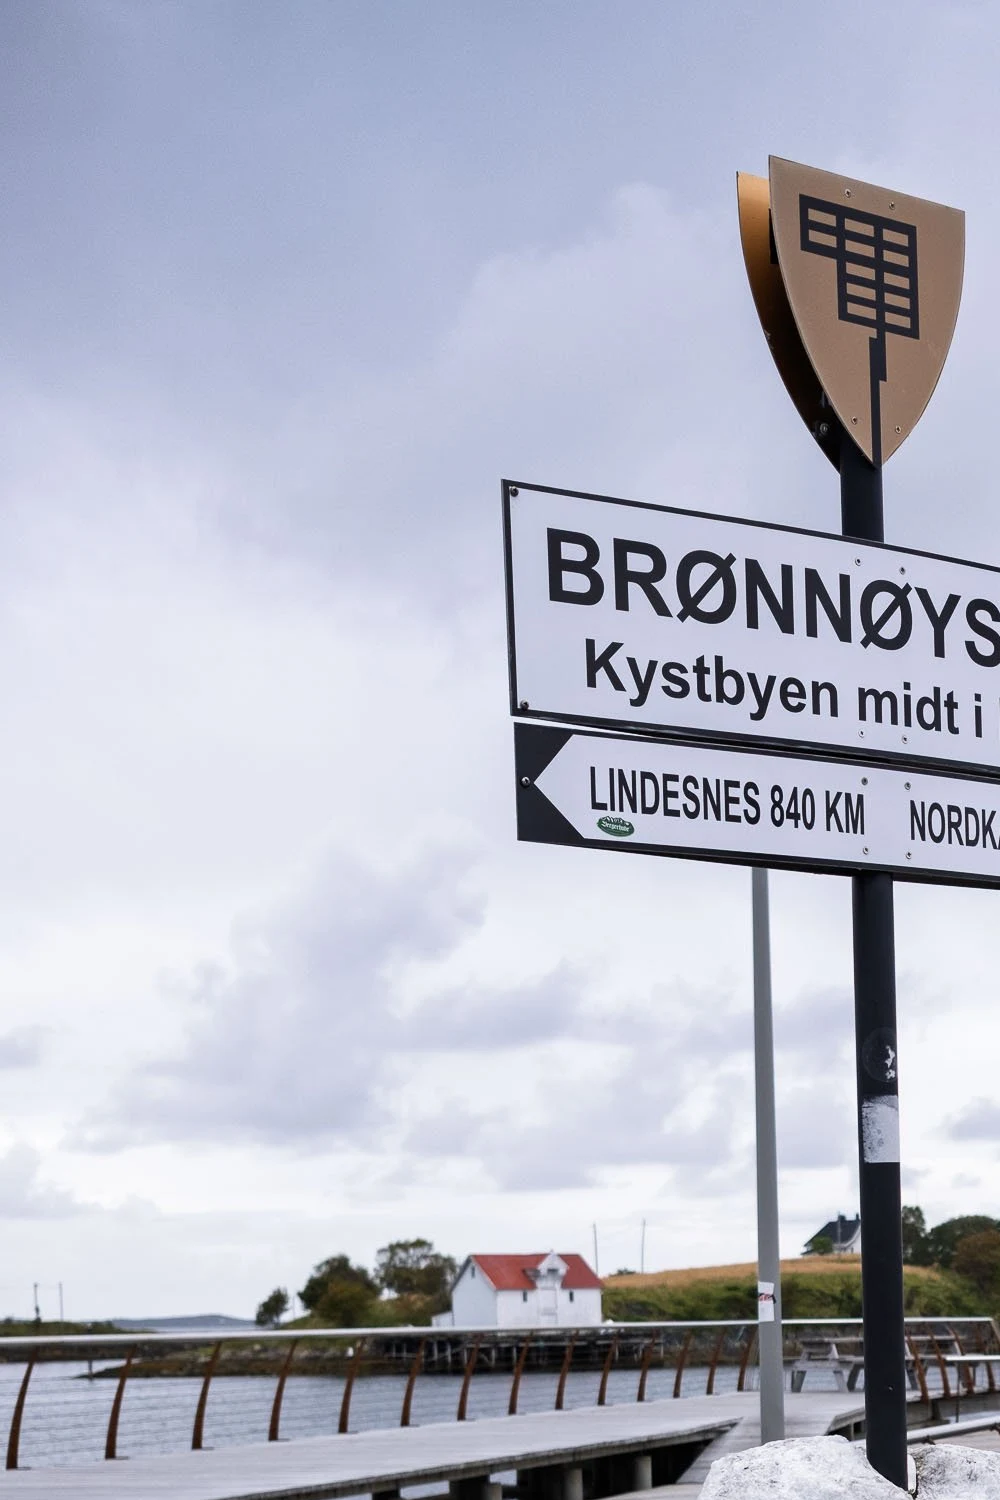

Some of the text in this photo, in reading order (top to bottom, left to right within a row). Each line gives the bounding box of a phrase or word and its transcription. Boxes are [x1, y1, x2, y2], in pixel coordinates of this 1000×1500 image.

[585, 638, 839, 722] Kystbyen
[857, 686, 960, 735] midt
[974, 695, 983, 739] i
[590, 766, 865, 836] LINDESNES 840 KM
